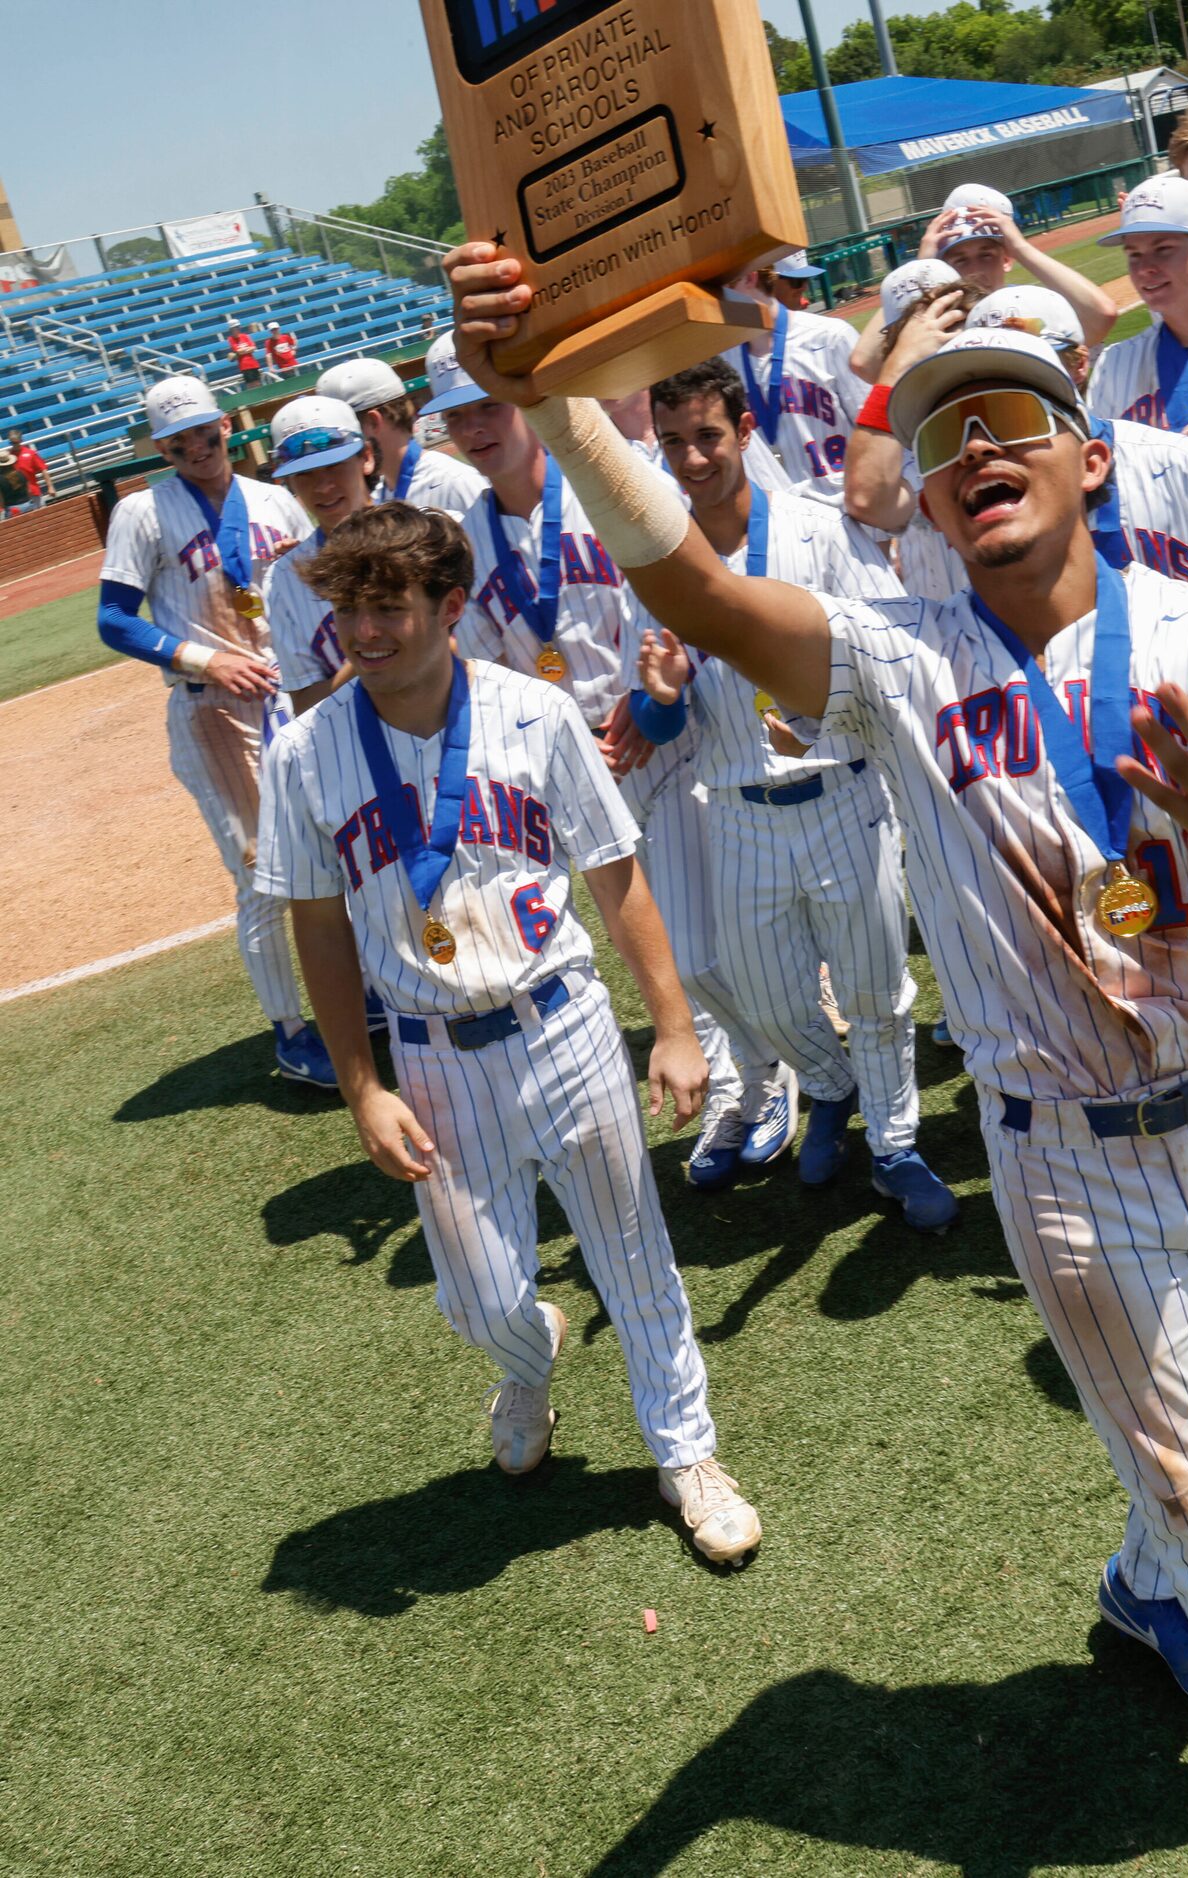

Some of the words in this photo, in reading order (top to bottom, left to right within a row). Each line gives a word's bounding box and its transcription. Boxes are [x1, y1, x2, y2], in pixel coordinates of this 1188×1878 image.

[493, 102, 538, 145] AND
[540, 28, 672, 117] PAROCHIAL
[510, 64, 541, 99] OF
[543, 8, 637, 82] PRIVATE
[530, 78, 641, 156] SCHOOLS
[898, 127, 1001, 161] MAVERICK
[993, 106, 1091, 139] BASEBALL
[533, 195, 576, 227] State
[577, 149, 668, 204] Champion
[544, 168, 577, 199] 2023
[580, 129, 648, 179] Baseball
[574, 195, 626, 230] Division
[622, 227, 668, 263] with
[667, 196, 733, 243] Honor
[510, 881, 558, 954] 6
